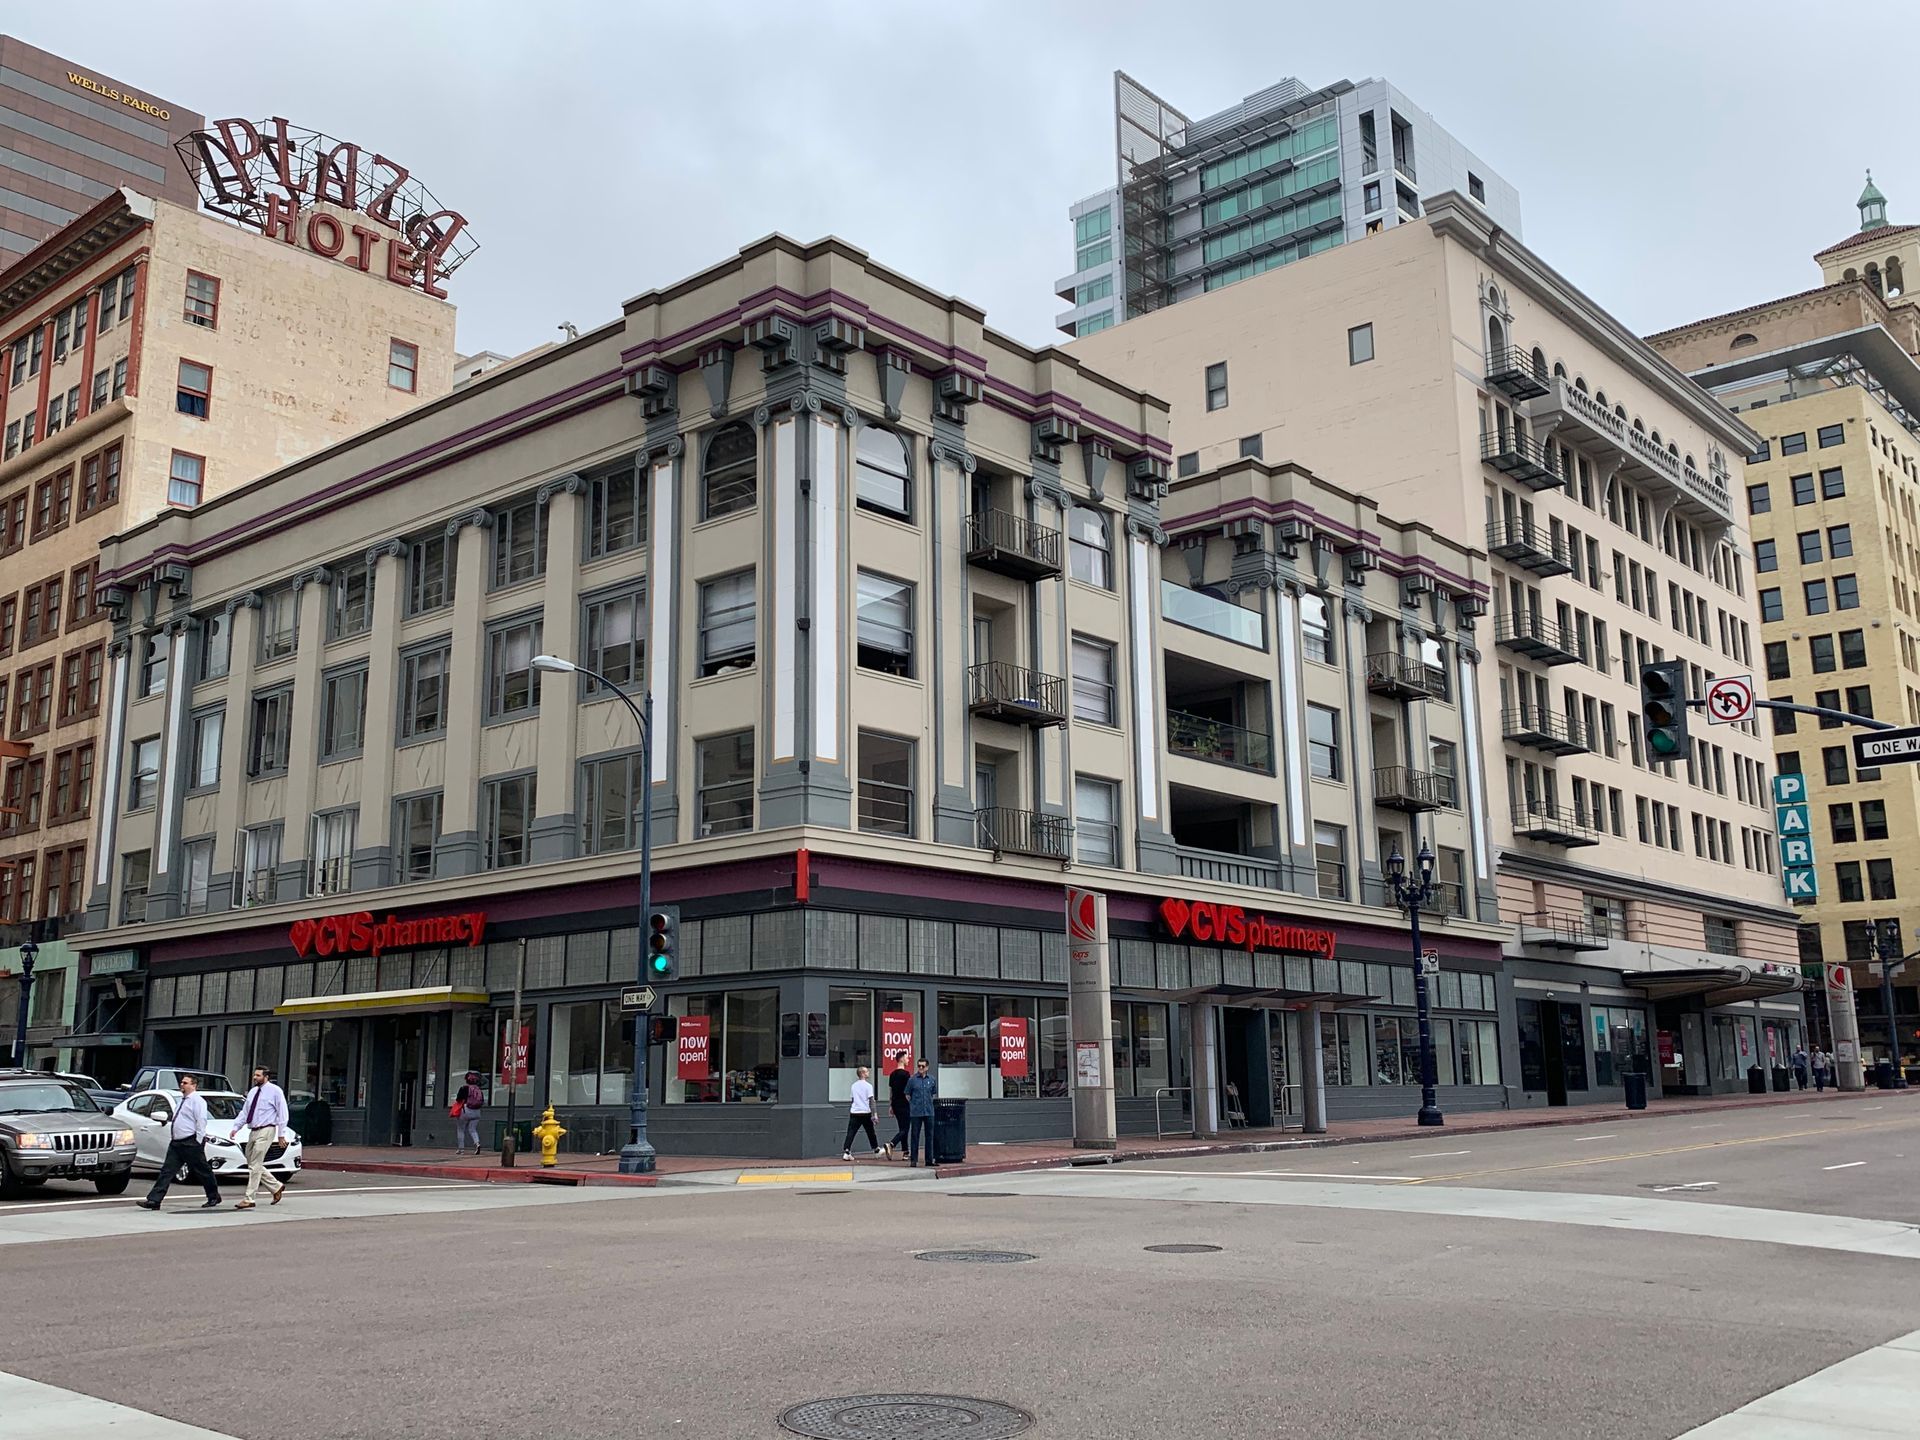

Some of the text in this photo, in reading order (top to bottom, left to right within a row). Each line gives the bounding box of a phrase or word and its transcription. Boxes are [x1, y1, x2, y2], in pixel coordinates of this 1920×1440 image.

[67, 72, 170, 120] WELLS FARGO
[213, 116, 469, 259] PLAZA
[264, 192, 448, 300] HOTEL
[1872, 738, 1920, 755] ONE W
[1780, 778, 1813, 893] PARK
[314, 911, 488, 958] CVS pharmacy
[1191, 901, 1336, 960] CVS pharmacy
[625, 993, 646, 1003] ONE WAY
[680, 1036, 708, 1049] now
[884, 1032, 912, 1045] now
[1001, 1035, 1026, 1047] now
[504, 1046, 527, 1057] nw
[679, 1049, 707, 1064] open!
[1001, 1048, 1026, 1062] open!
